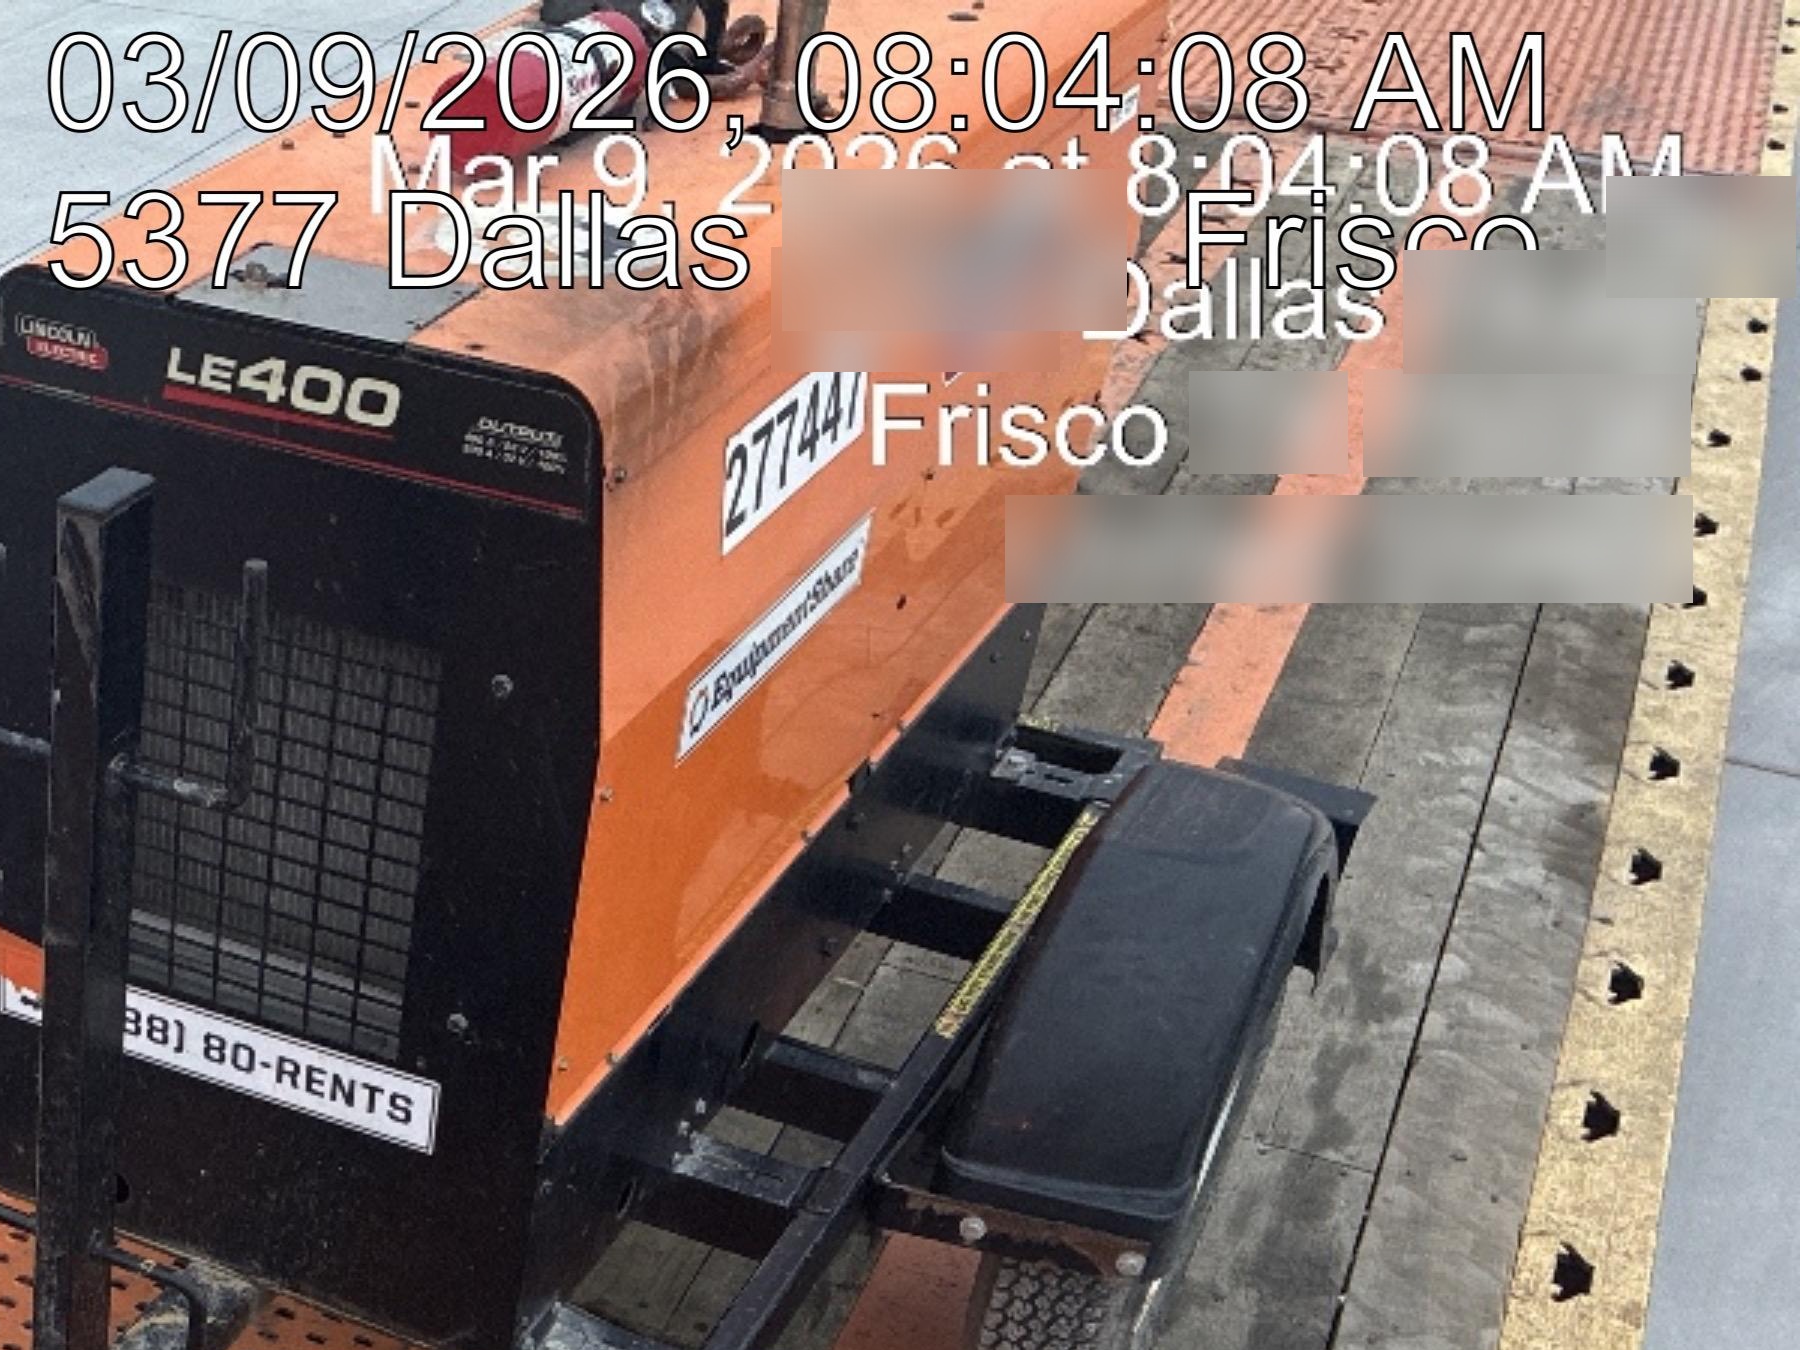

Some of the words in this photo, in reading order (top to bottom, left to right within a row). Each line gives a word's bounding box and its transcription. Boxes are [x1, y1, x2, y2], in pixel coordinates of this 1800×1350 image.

[166, 346, 401, 428] LE400
[711, 548, 861, 711] EquipmentShare
[202, 1032, 416, 1126] 80-RENTS
